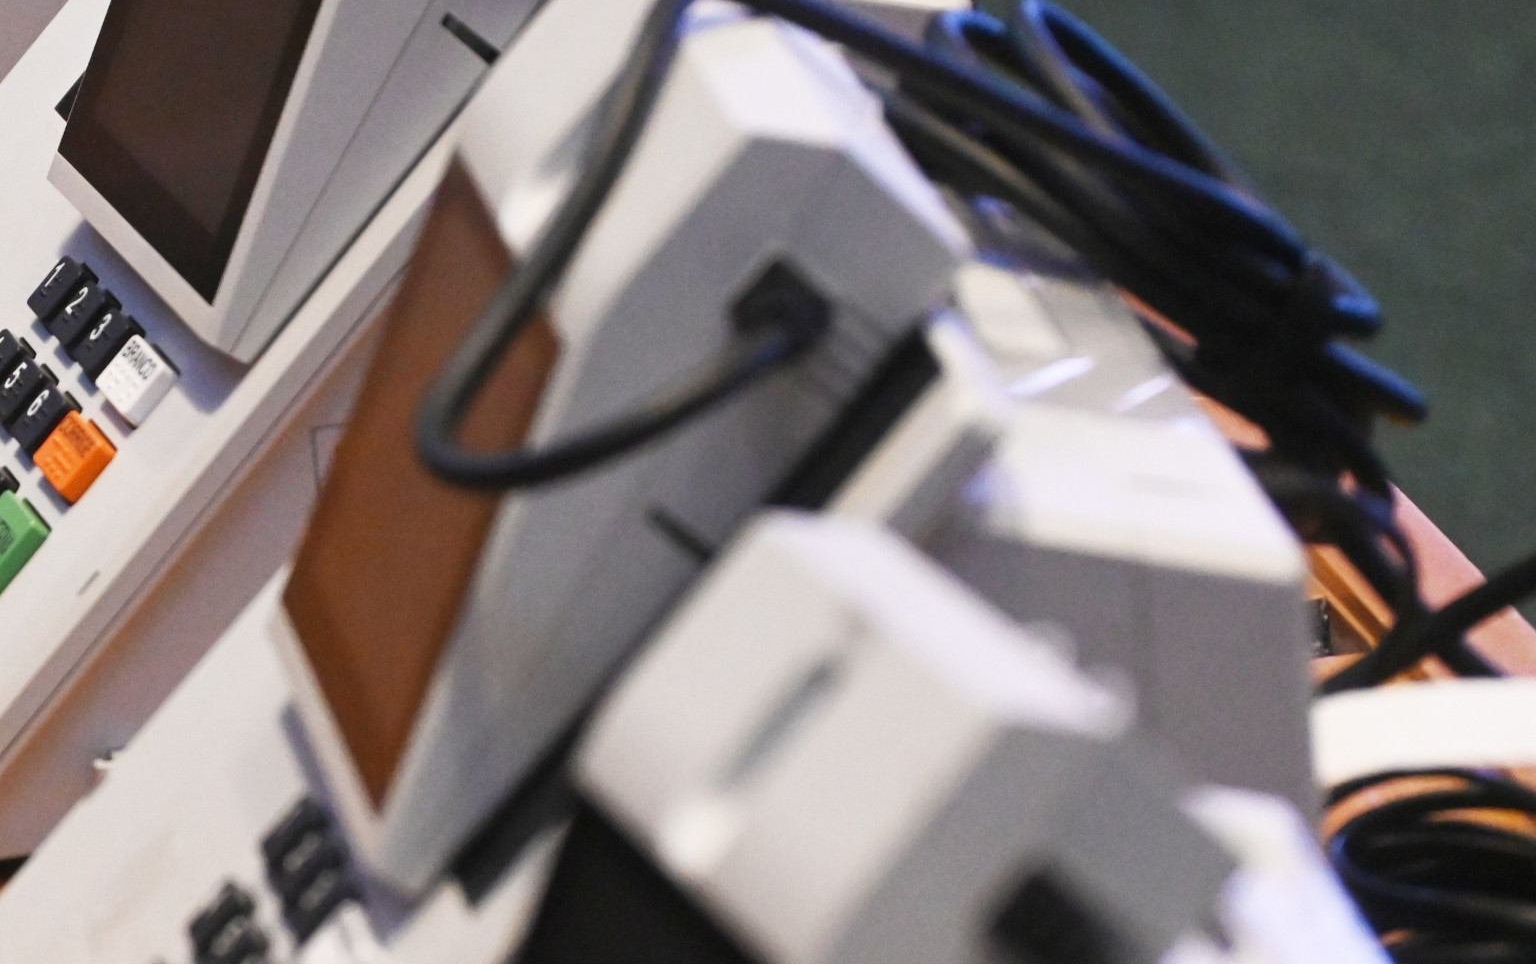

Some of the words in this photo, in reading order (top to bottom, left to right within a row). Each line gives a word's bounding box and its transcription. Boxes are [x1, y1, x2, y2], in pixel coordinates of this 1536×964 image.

[44, 262, 65, 287] 1
[65, 286, 88, 315] 2
[89, 313, 112, 340] 3
[122, 338, 158, 381] BRANCO
[4, 362, 27, 389] 5
[27, 389, 50, 416] 6
